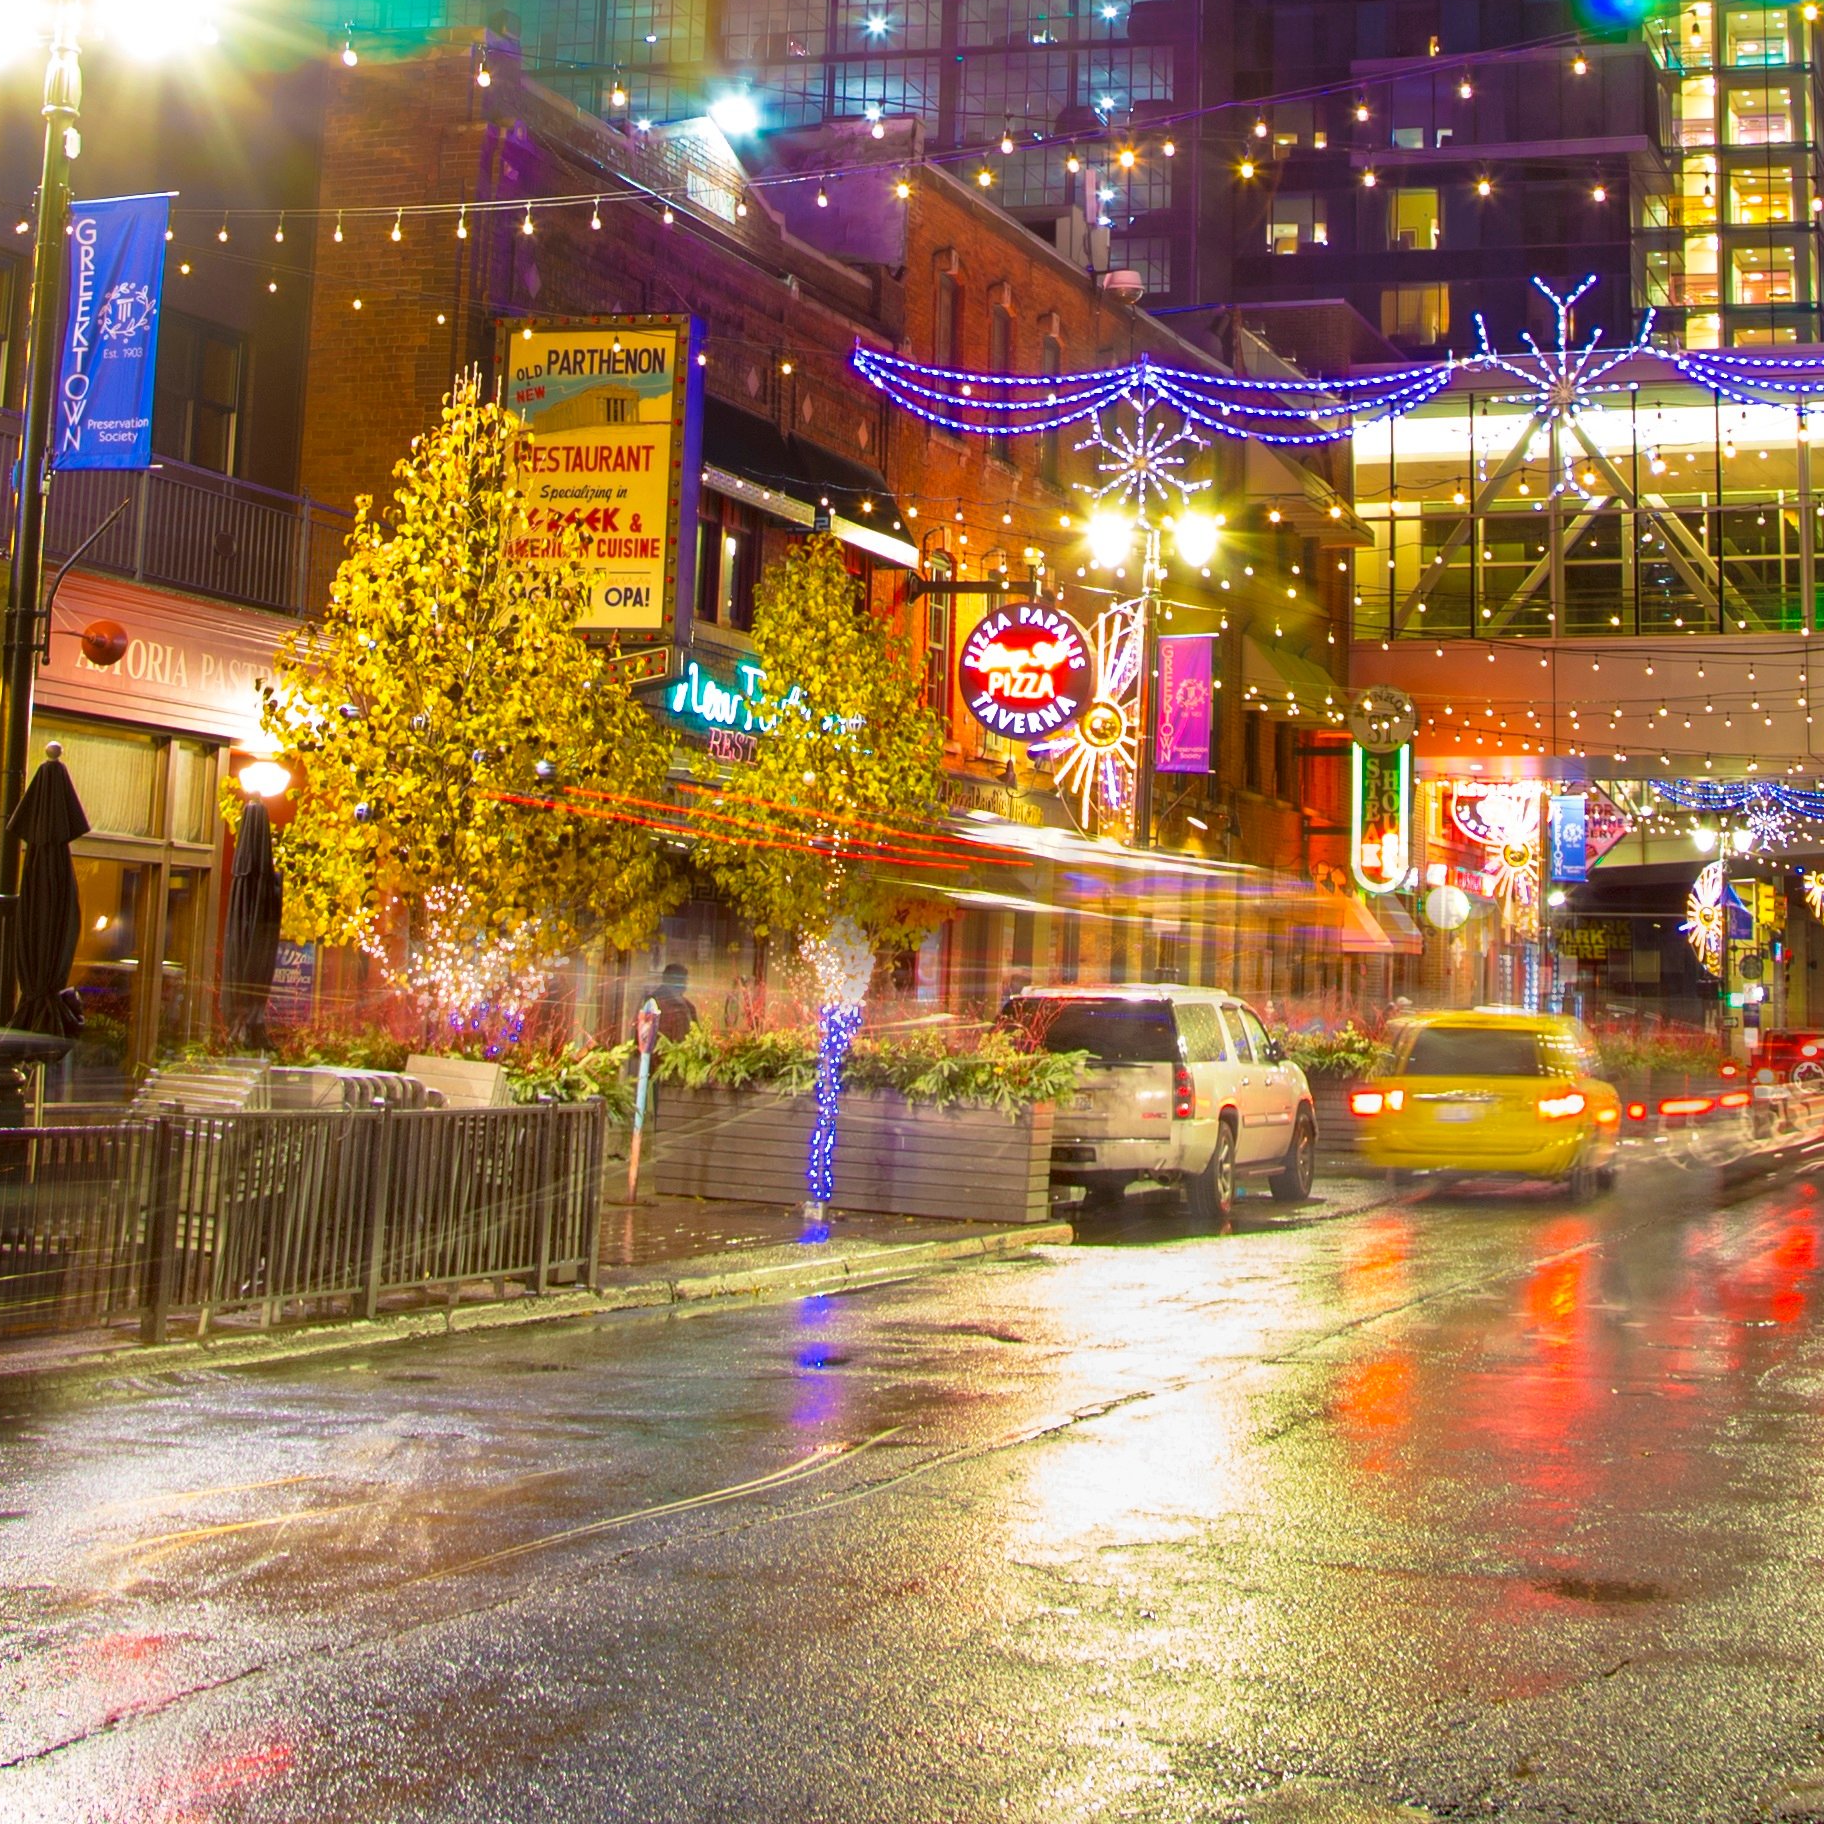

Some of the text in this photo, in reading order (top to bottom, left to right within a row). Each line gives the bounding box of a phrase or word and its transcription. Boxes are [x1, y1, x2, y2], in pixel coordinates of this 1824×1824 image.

[62, 218, 97, 452] GREEKTOWN
[103, 346, 143, 359] Est. 1903
[516, 347, 666, 382] OLD PARTHENON
[516, 385, 546, 404] NEW
[87, 416, 149, 430] Preservation
[98, 430, 139, 444] Society
[540, 484, 628, 503] Specializing in
[629, 513, 643, 533] &
[596, 537, 660, 559] CUISINE
[604, 587, 651, 608] OPA!
[964, 613, 1012, 669] PIZZA
[1019, 607, 1086, 669] PAPALIS
[988, 671, 1055, 699] PIZZA
[972, 691, 1077, 734] TAVERNA
[1160, 644, 1174, 764] GREEKTOWN
